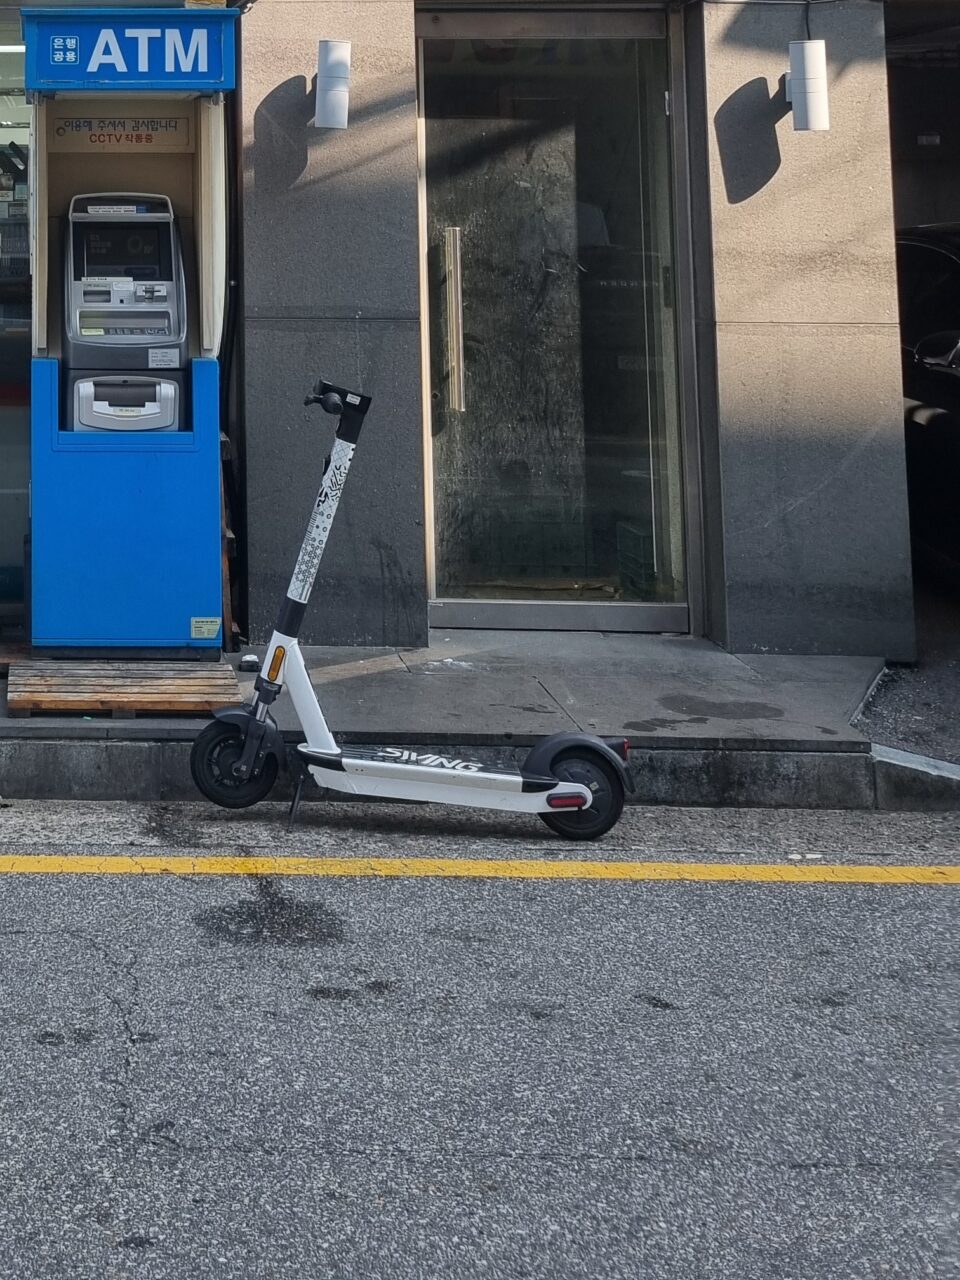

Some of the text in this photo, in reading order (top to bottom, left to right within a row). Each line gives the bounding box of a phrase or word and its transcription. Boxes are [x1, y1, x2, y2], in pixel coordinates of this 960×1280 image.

[52, 38, 77, 49] 은행
[86, 28, 208, 73] ATM
[52, 51, 77, 62] 공용
[131, 119, 178, 132] 감사합니다
[89, 133, 123, 144] CCTV
